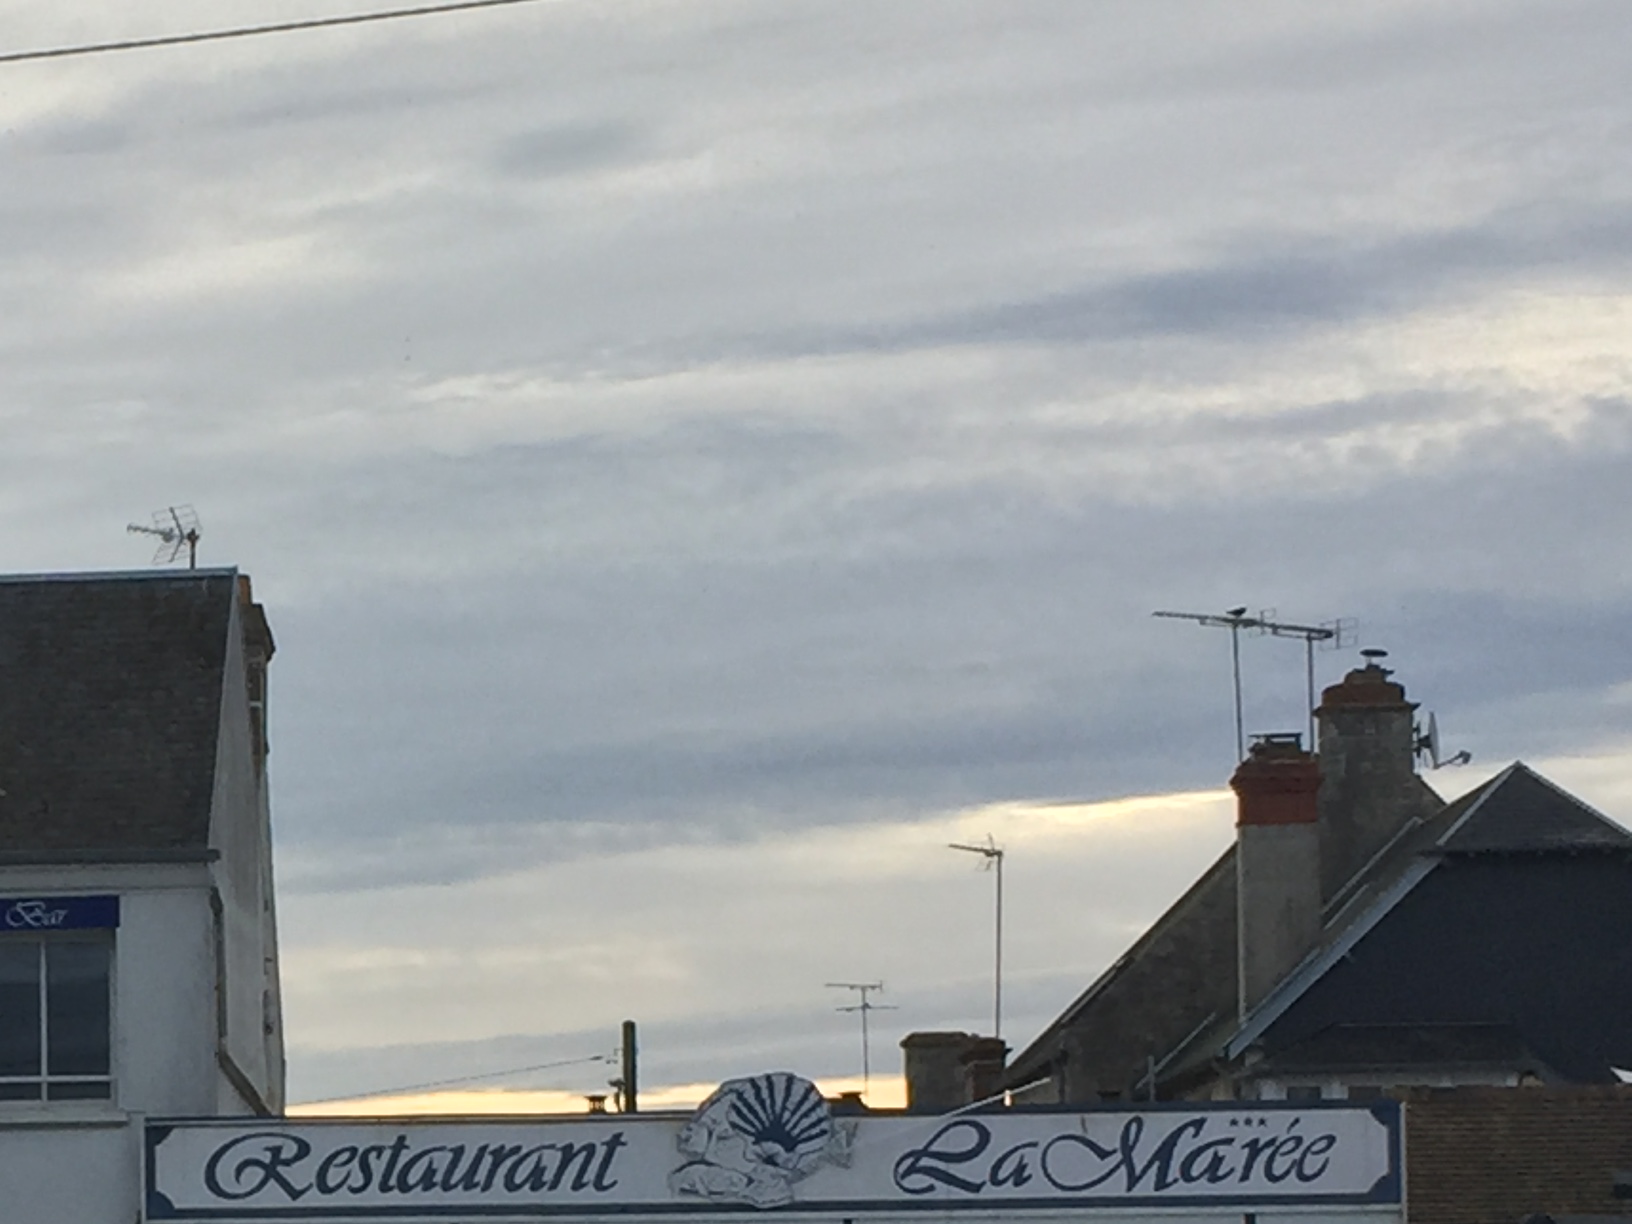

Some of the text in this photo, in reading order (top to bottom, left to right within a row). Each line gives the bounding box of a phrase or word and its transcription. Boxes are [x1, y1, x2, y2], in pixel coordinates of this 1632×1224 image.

[5, 899, 70, 928] Bar
[204, 1131, 628, 1201] Restaurant
[893, 1119, 1039, 1194] La
